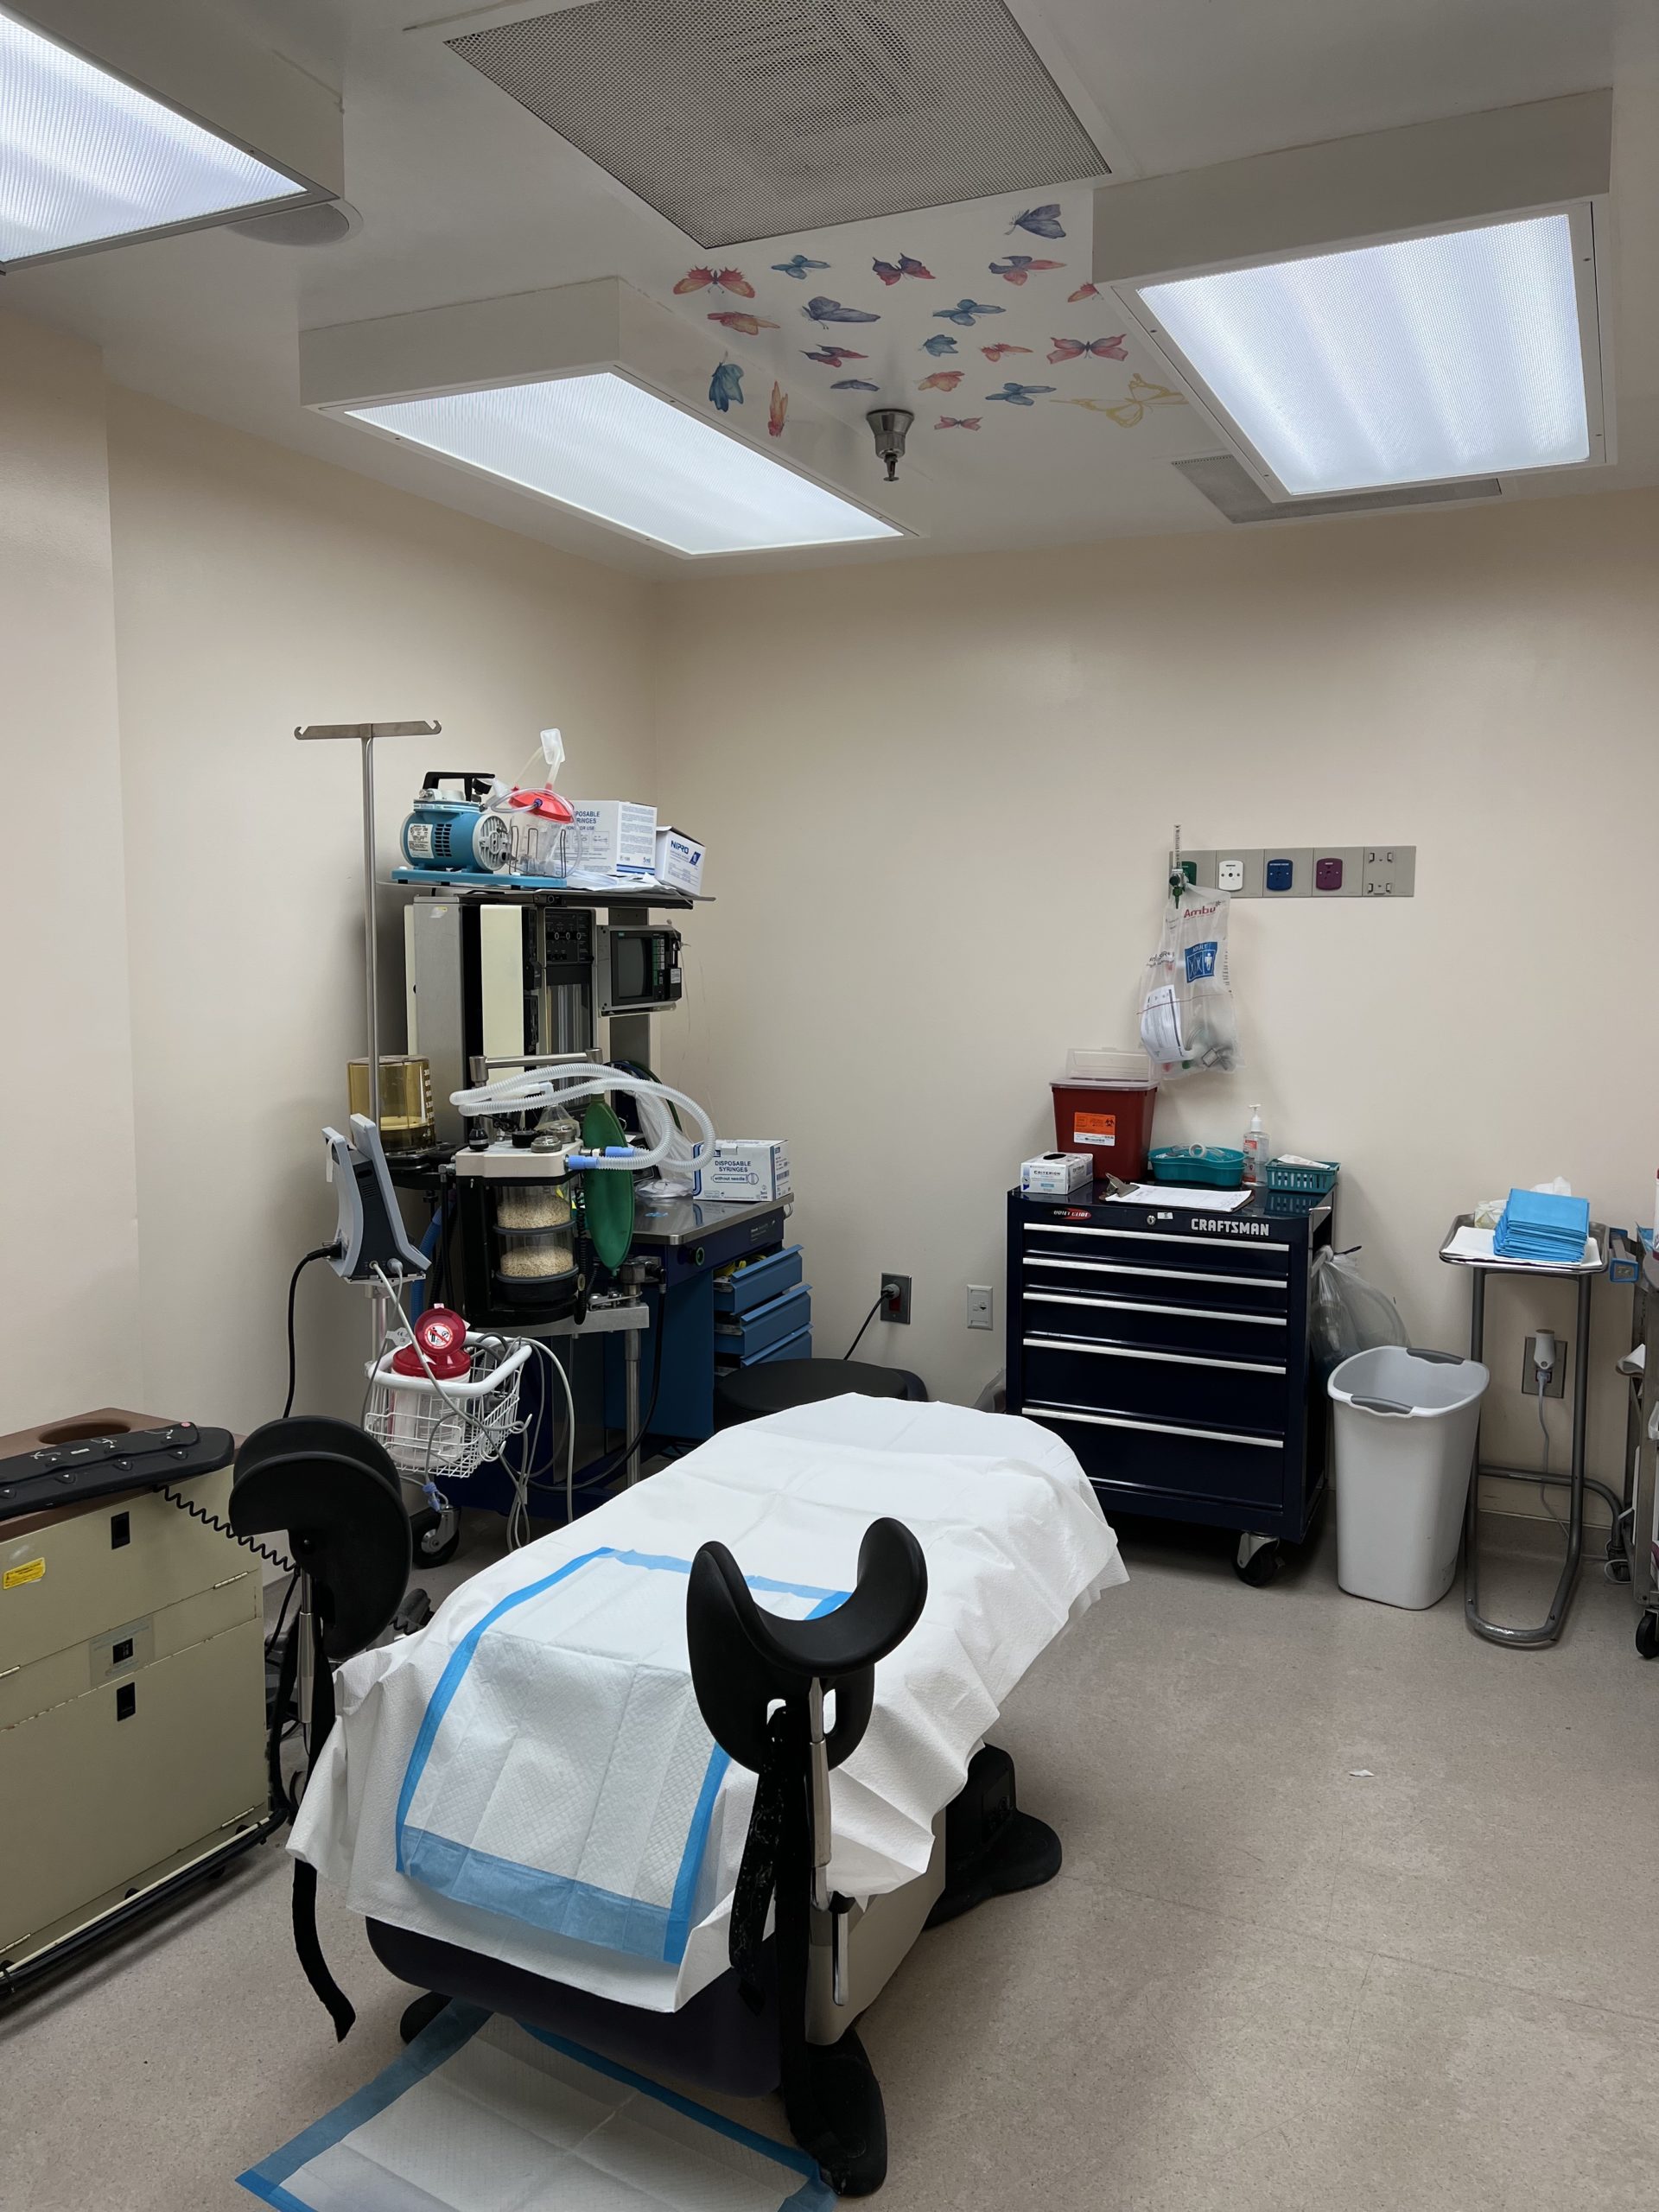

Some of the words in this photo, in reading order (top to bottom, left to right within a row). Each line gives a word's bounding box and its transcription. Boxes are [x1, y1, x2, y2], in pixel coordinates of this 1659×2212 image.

[671, 840, 690, 855] NIPRO
[1184, 906, 1216, 918] Ambu
[1191, 1217, 1270, 1236] CRAFTSMAN
